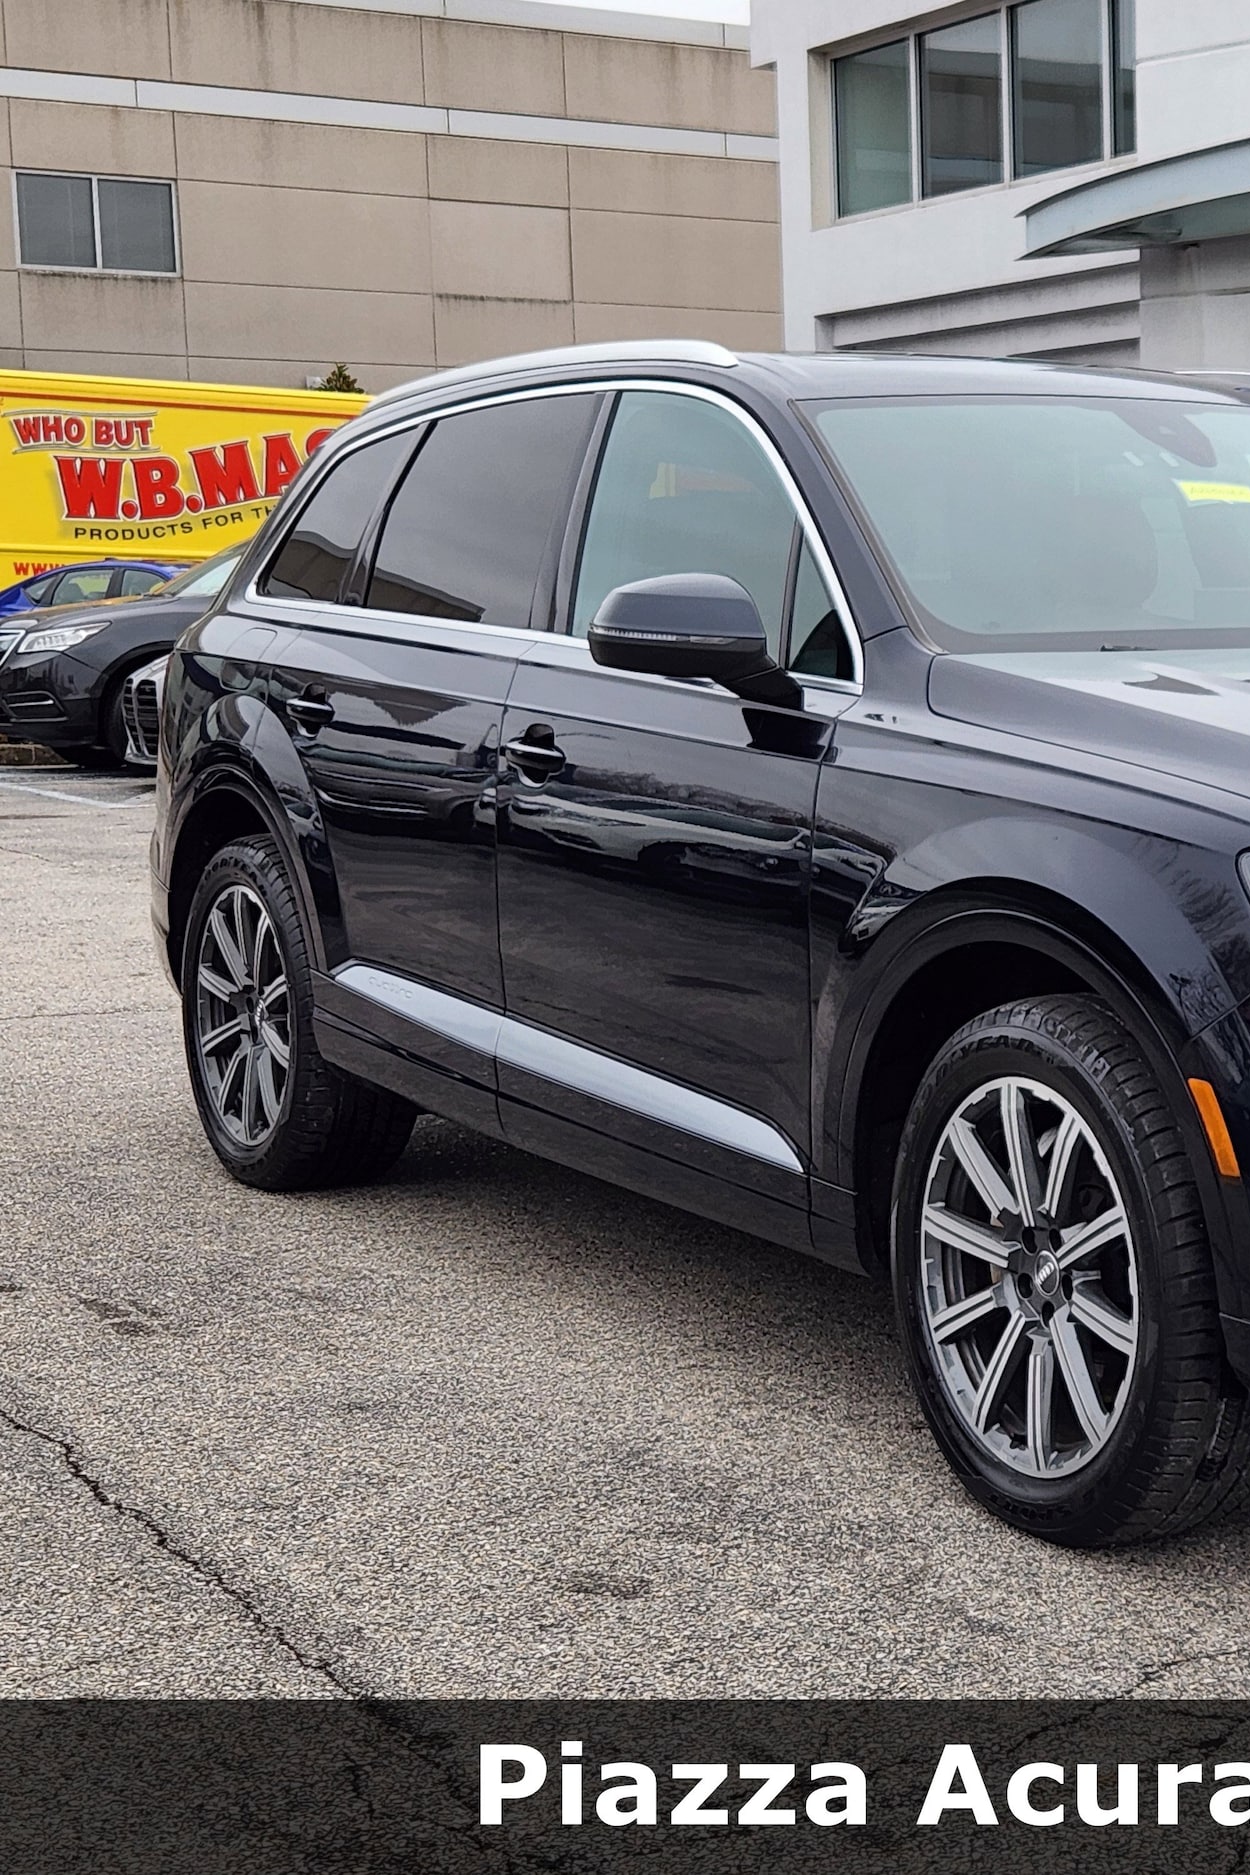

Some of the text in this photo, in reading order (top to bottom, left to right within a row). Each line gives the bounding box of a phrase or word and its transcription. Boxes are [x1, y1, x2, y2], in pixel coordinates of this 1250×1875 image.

[13, 416, 152, 446] WHO BUT
[74, 522, 193, 540] PRODUCTS
[202, 511, 243, 530] FOR
